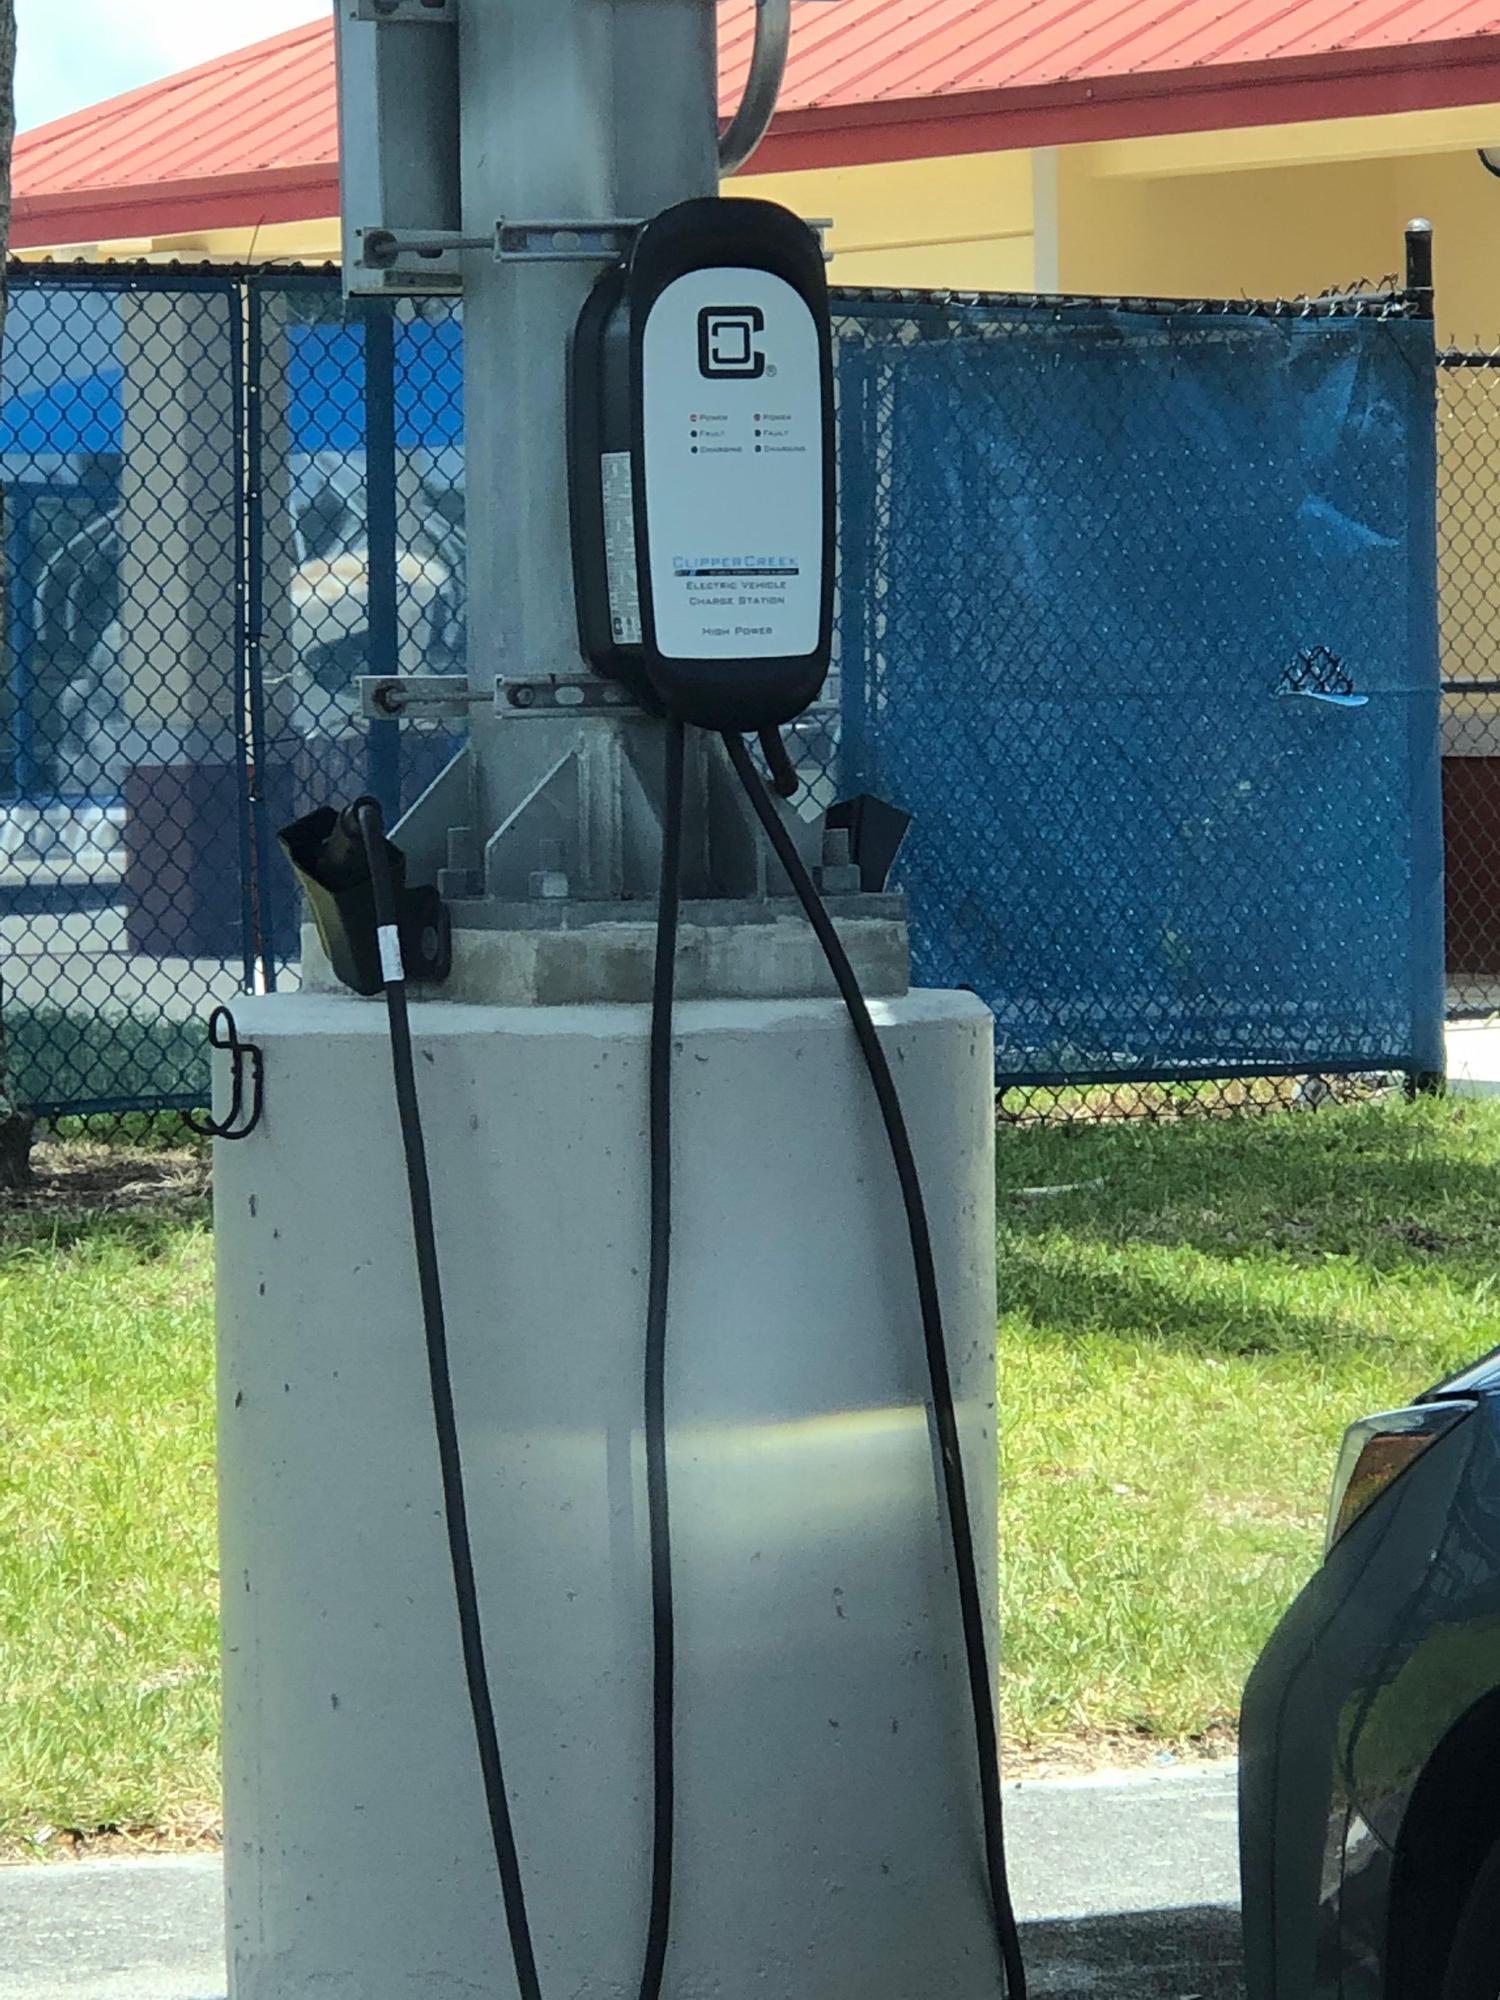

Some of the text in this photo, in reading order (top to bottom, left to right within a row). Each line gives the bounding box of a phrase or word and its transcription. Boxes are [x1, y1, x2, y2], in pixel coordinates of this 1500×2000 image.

[686, 581, 787, 590] ELECTRIC VEHICLE
[689, 596, 785, 606] CHARGE STATION
[702, 627, 773, 636] HIGH POWER
